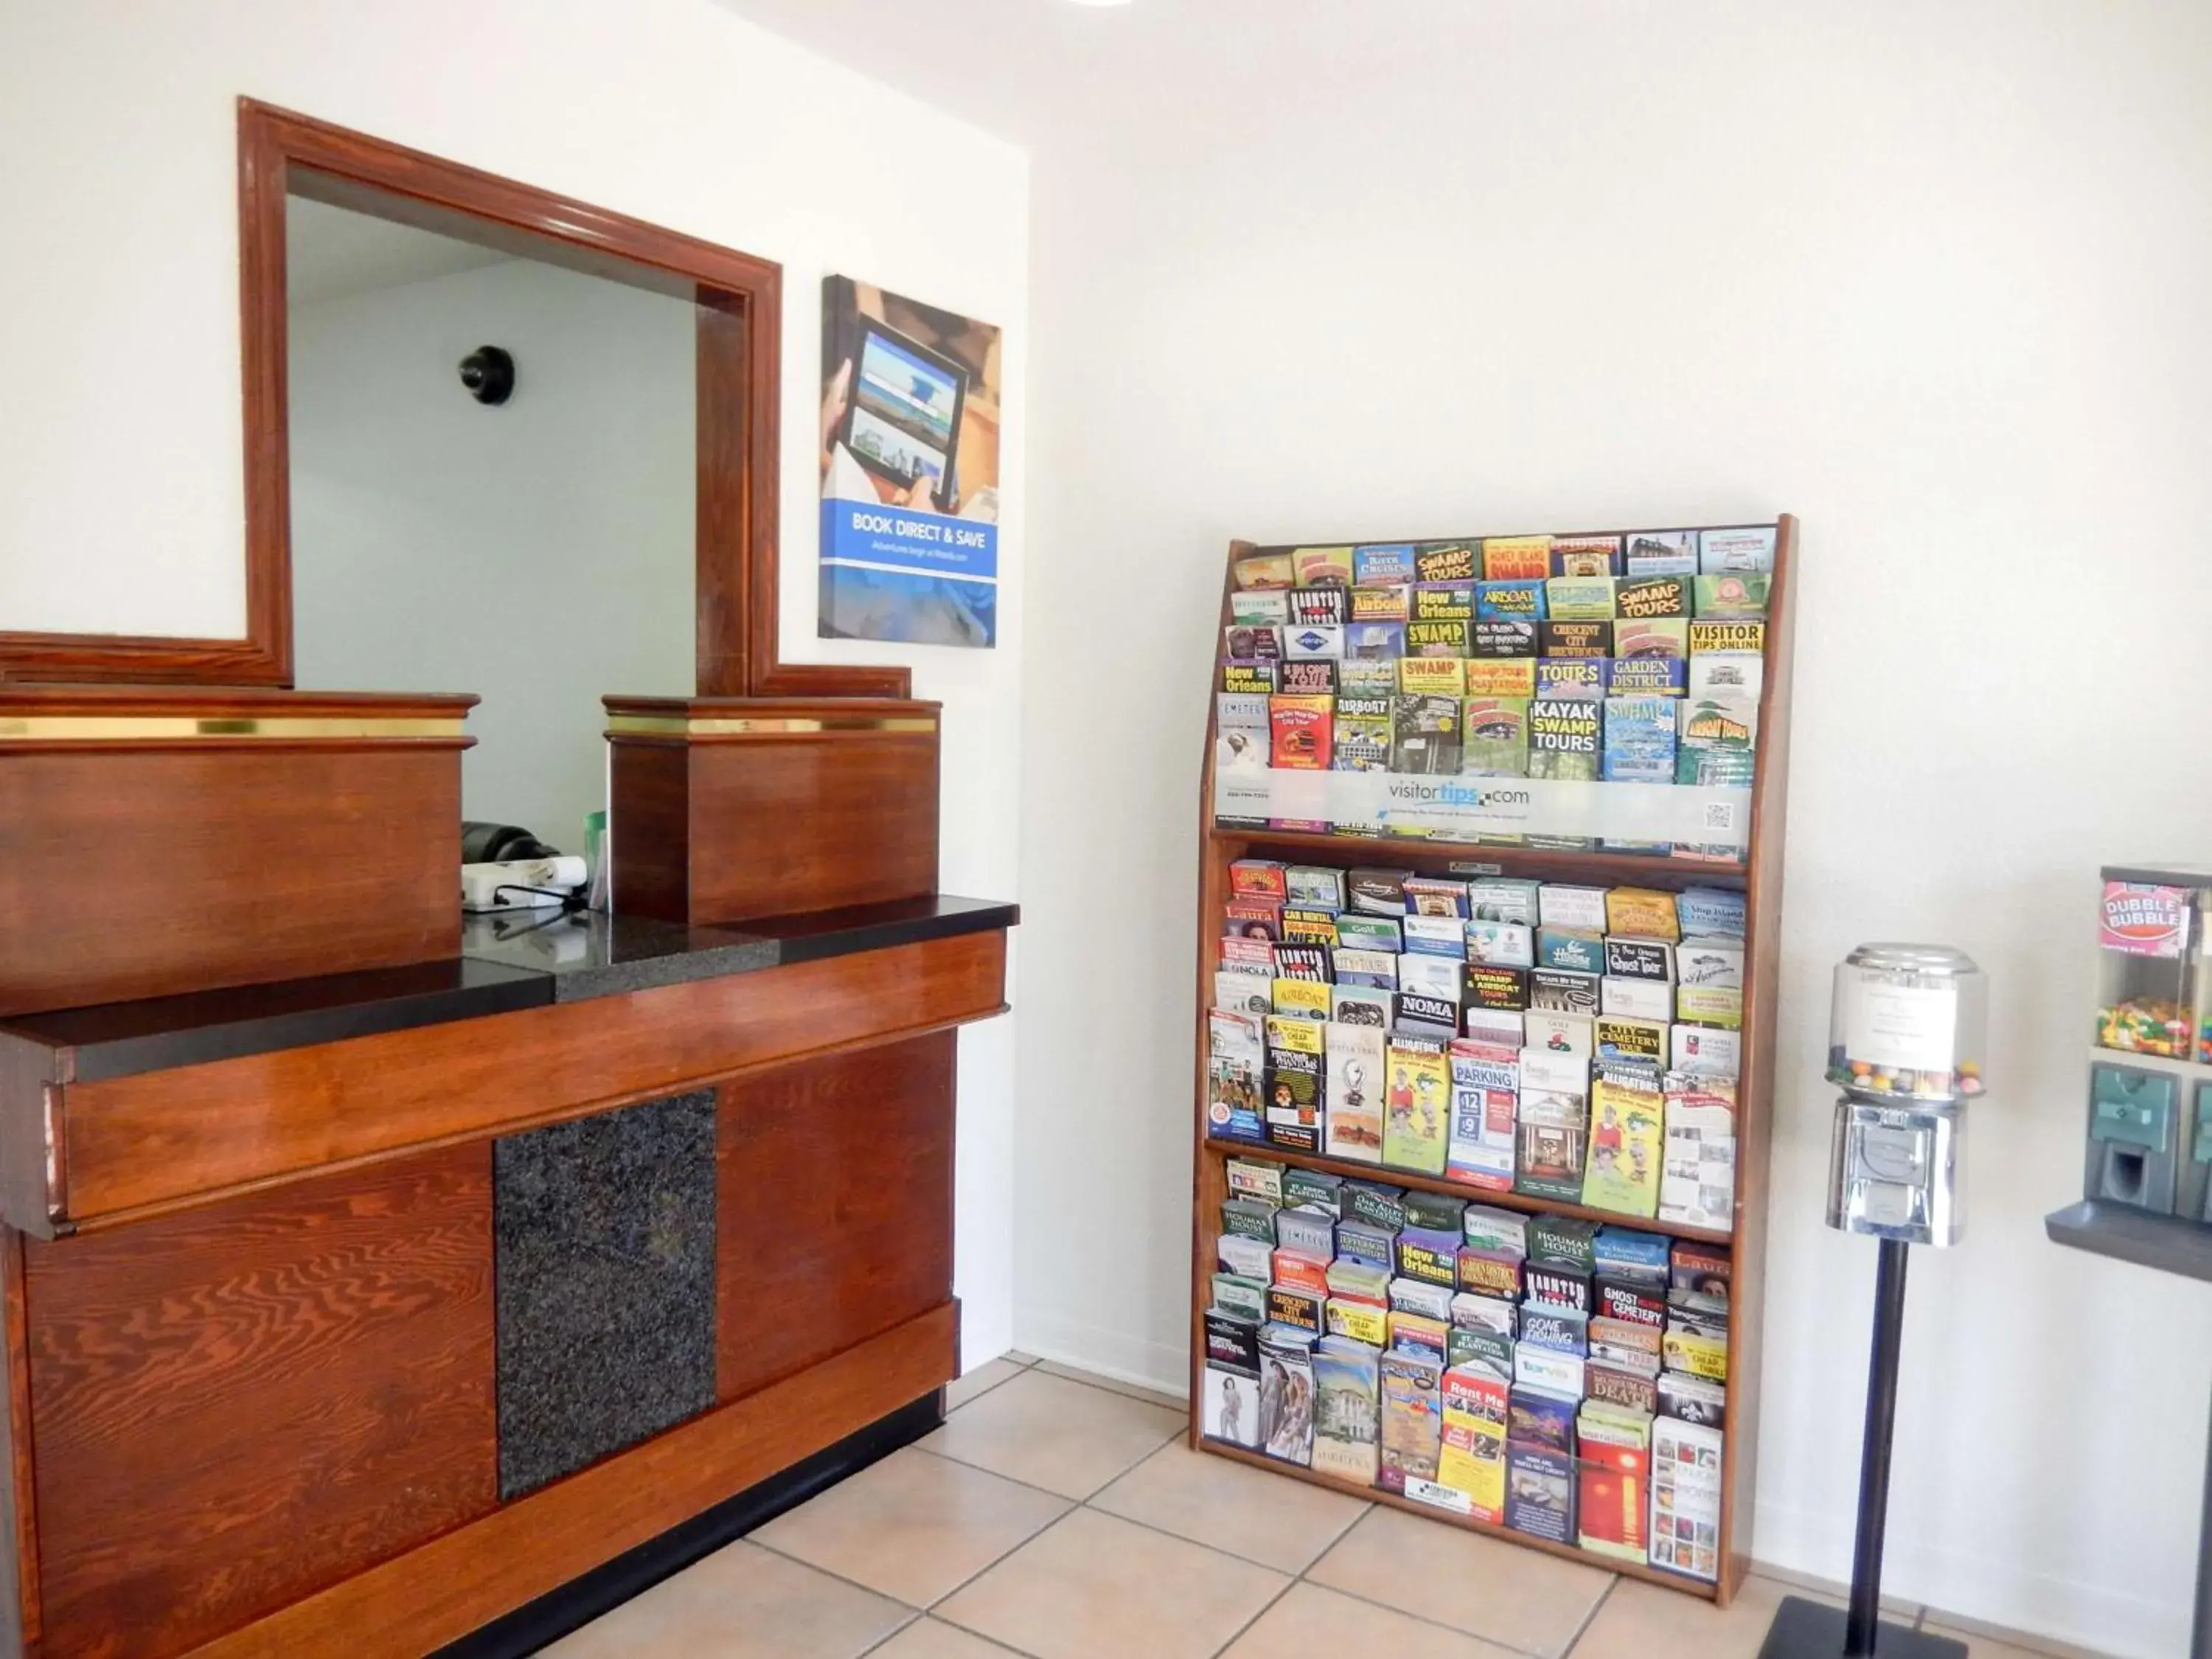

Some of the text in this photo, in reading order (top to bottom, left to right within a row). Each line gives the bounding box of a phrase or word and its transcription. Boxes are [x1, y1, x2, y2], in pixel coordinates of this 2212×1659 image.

[852, 512, 986, 549] BOOK DIRECT & SAVE
[1417, 550, 1472, 571] SWAMP
[1423, 564, 1473, 582] TOURS
[1291, 591, 1341, 610] HAUNTED
[1418, 590, 1450, 604] New
[1618, 583, 1680, 605] SWAMP
[1419, 604, 1472, 619] Orleans
[1624, 599, 1681, 617] TOURS
[1408, 625, 1464, 643] SWAMP
[1552, 625, 1600, 636] CRESCENT
[1694, 625, 1759, 639] VISITOR
[1565, 636, 1587, 647] CITY
[1693, 639, 1759, 650] TIPS ONLINE
[1225, 666, 1253, 679] New
[1405, 661, 1455, 675] SWAMP
[1539, 664, 1599, 682] TOURS
[1613, 661, 1670, 673] GARDEN
[1226, 679, 1272, 692] Orleans
[1612, 674, 1672, 687] DISTRICT
[1338, 700, 1387, 715] AIRBOAT
[1534, 701, 1596, 720] KAYAK
[1533, 718, 1597, 735] SWAMP
[1536, 734, 1595, 751] TOURS
[1225, 906, 1273, 922] Laura
[2106, 897, 2176, 915] DUBBLE
[2109, 911, 2181, 929] BUBBLE
[1352, 925, 1376, 934] Golf
[1638, 956, 1664, 974] Tour
[1475, 973, 1513, 984] SWAMP
[1477, 982, 1520, 994] AIRBOAT
[1480, 990, 1509, 999] TOURS
[1402, 996, 1454, 1018] NOMA
[1608, 1024, 1636, 1034] CITY
[1599, 1032, 1660, 1048] CEMETERY
[1618, 1043, 1643, 1054] TOUR
[1456, 1066, 1512, 1087] PARKING
[1602, 1071, 1660, 1092] ALLIGATORS
[1225, 1212, 1267, 1228] HOUMAS
[1537, 1230, 1589, 1251] HOUMAS
[1543, 1241, 1585, 1256] HOUSE
[1403, 1245, 1433, 1262] New
[1403, 1257, 1454, 1280] Orleans
[1526, 1272, 1585, 1300] HAUNTED
[1604, 1287, 1638, 1305] GHOST
[1613, 1301, 1663, 1324] CEMETERY
[1526, 1318, 1562, 1333] GONE
[1526, 1329, 1573, 1344] FISHING
[1450, 1381, 1506, 1408] Rent Me
[1594, 1381, 1653, 1409] DEATH
